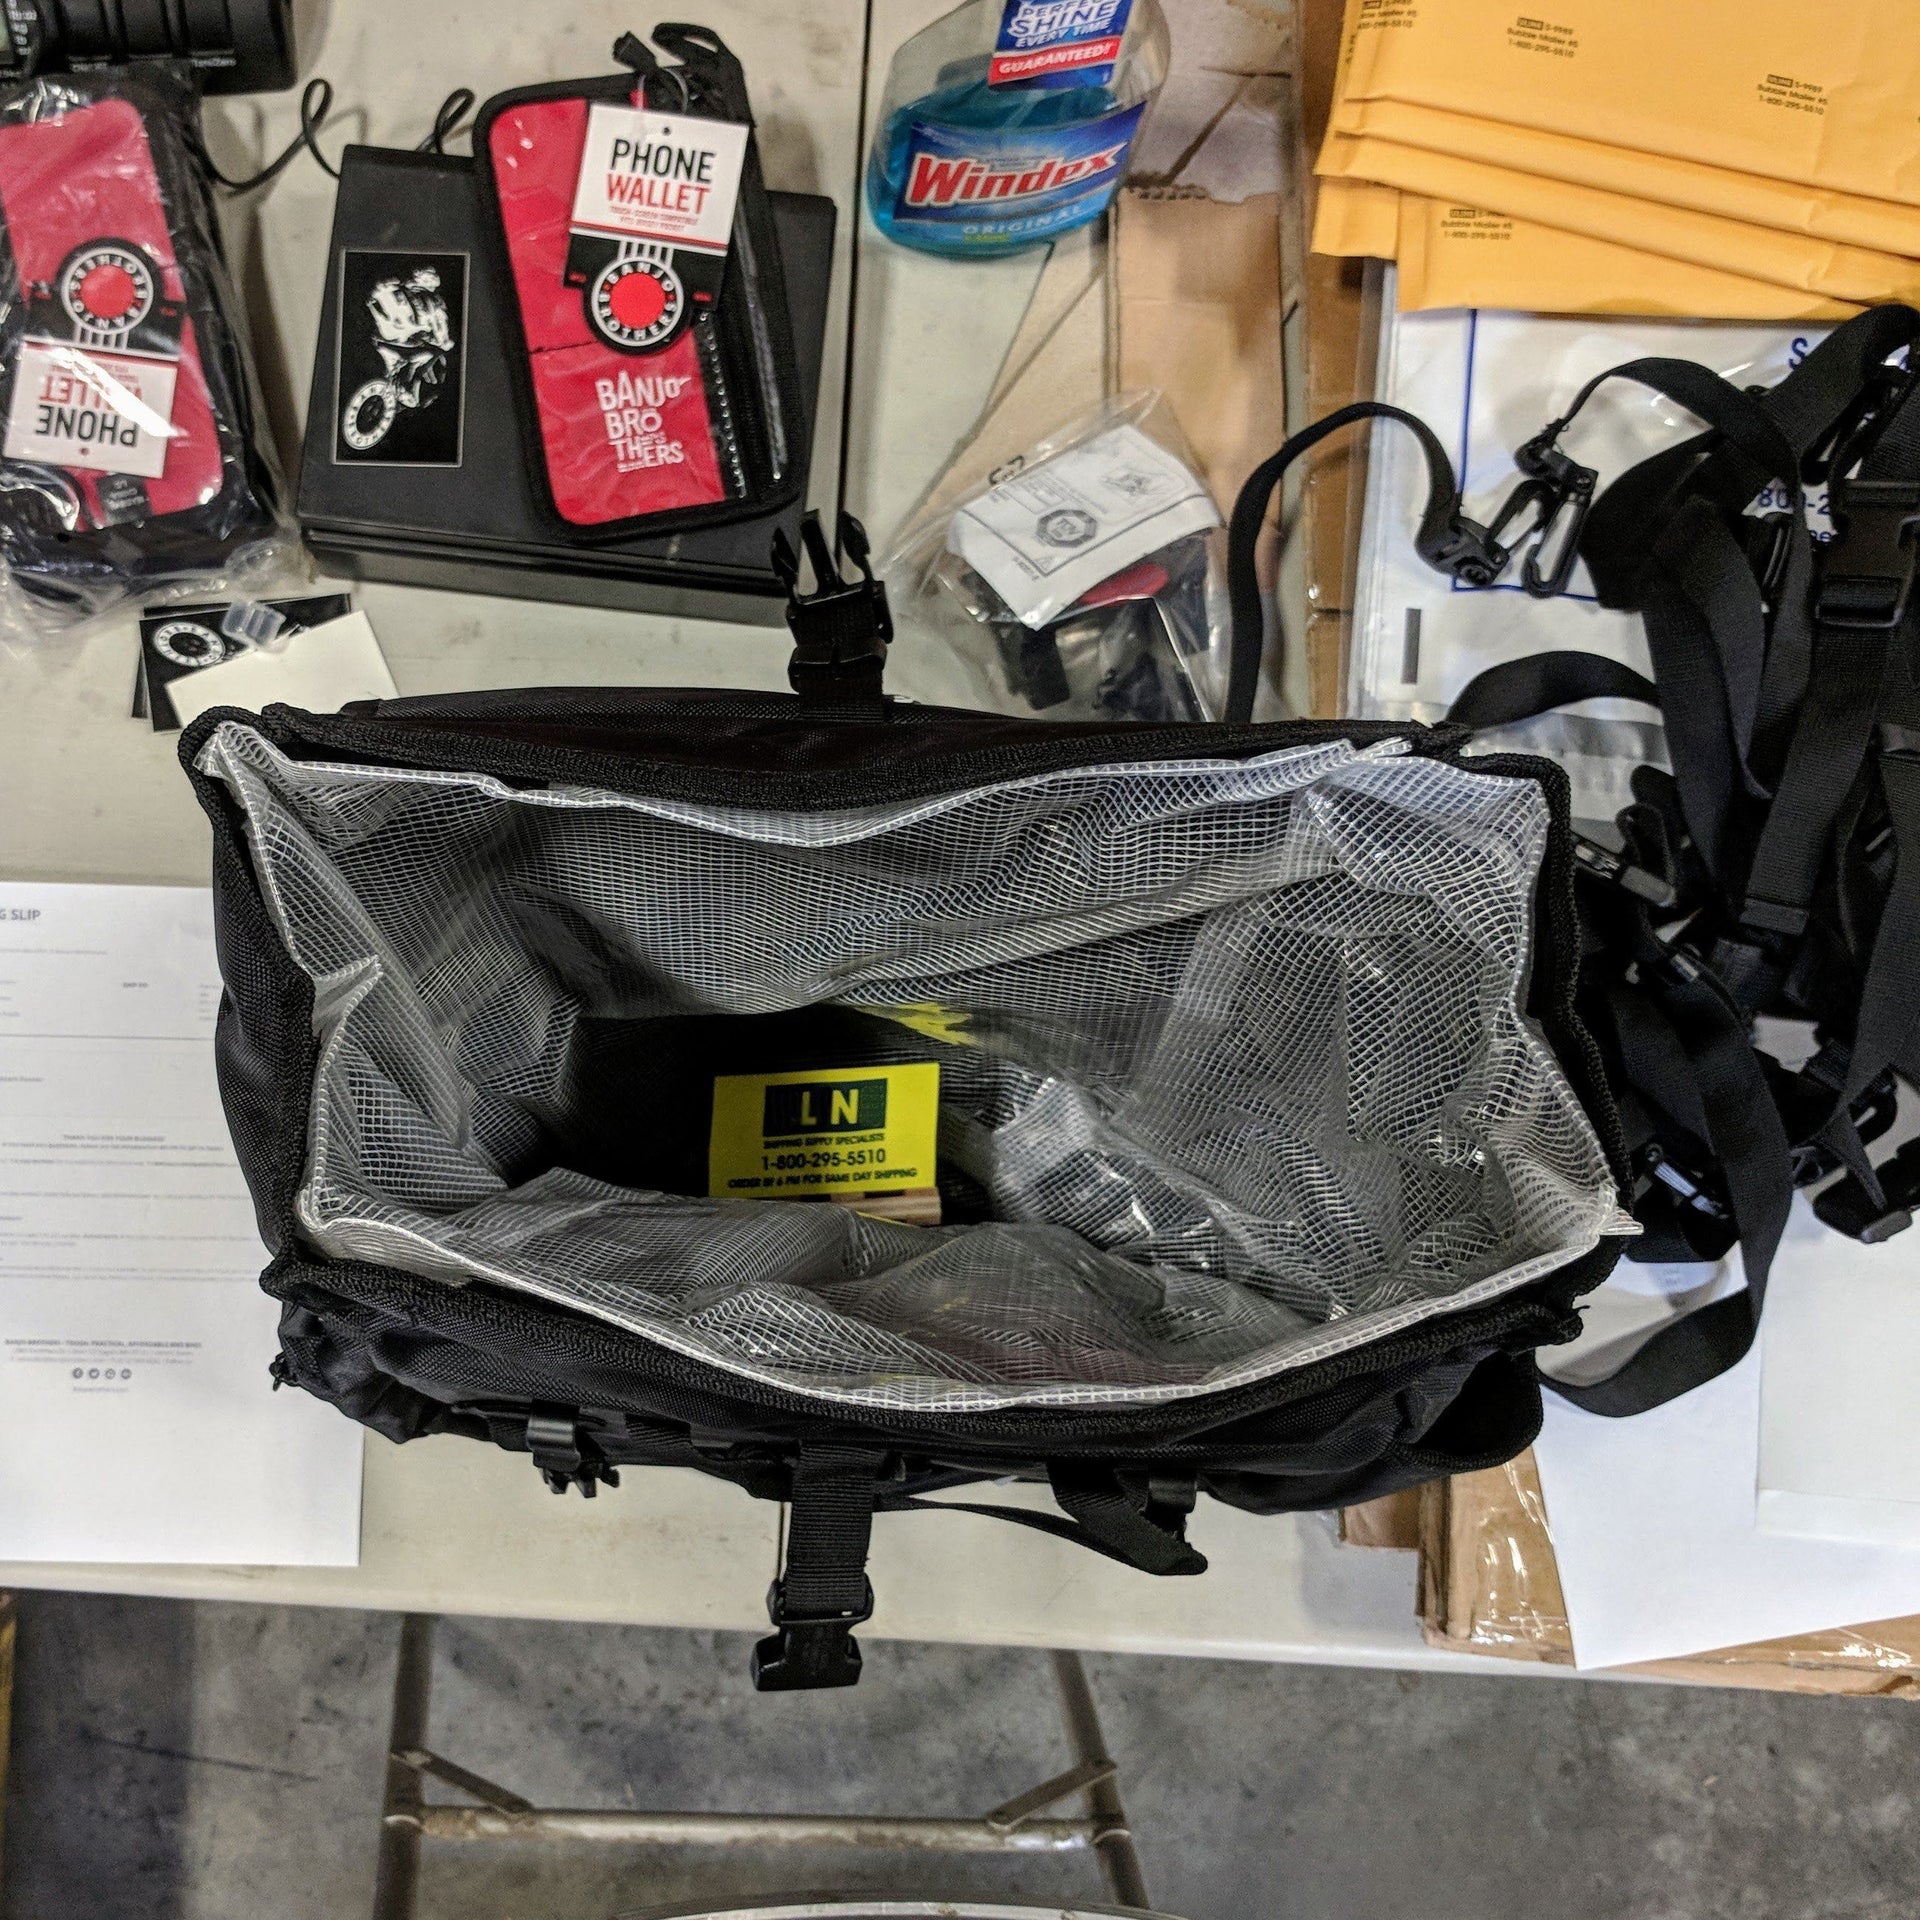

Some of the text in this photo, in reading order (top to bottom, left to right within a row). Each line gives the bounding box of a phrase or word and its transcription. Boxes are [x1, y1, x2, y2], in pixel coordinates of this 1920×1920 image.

[1011, 1, 1116, 36] SHINE
[1022, 0, 1106, 17] PERFE
[1015, 18, 1112, 48] EVERY TIME
[998, 42, 1115, 74] GUARANTEED!
[611, 138, 717, 184] PHONE
[905, 142, 1126, 208] Windex
[607, 173, 711, 214] WALLET
[606, 262, 675, 292] BANJO
[598, 291, 677, 341] BROTHERS
[595, 369, 692, 411] BANJO
[35, 404, 139, 448] PHONE
[605, 407, 663, 440] BRO
[11, 908, 42, 921] SLIP
[761, 1149, 886, 1171] 1-800-295-5510
[803, 1173, 822, 1184] FOR
[853, 1170, 872, 1181] DAY
[874, 1167, 917, 1180] SHIPPING
